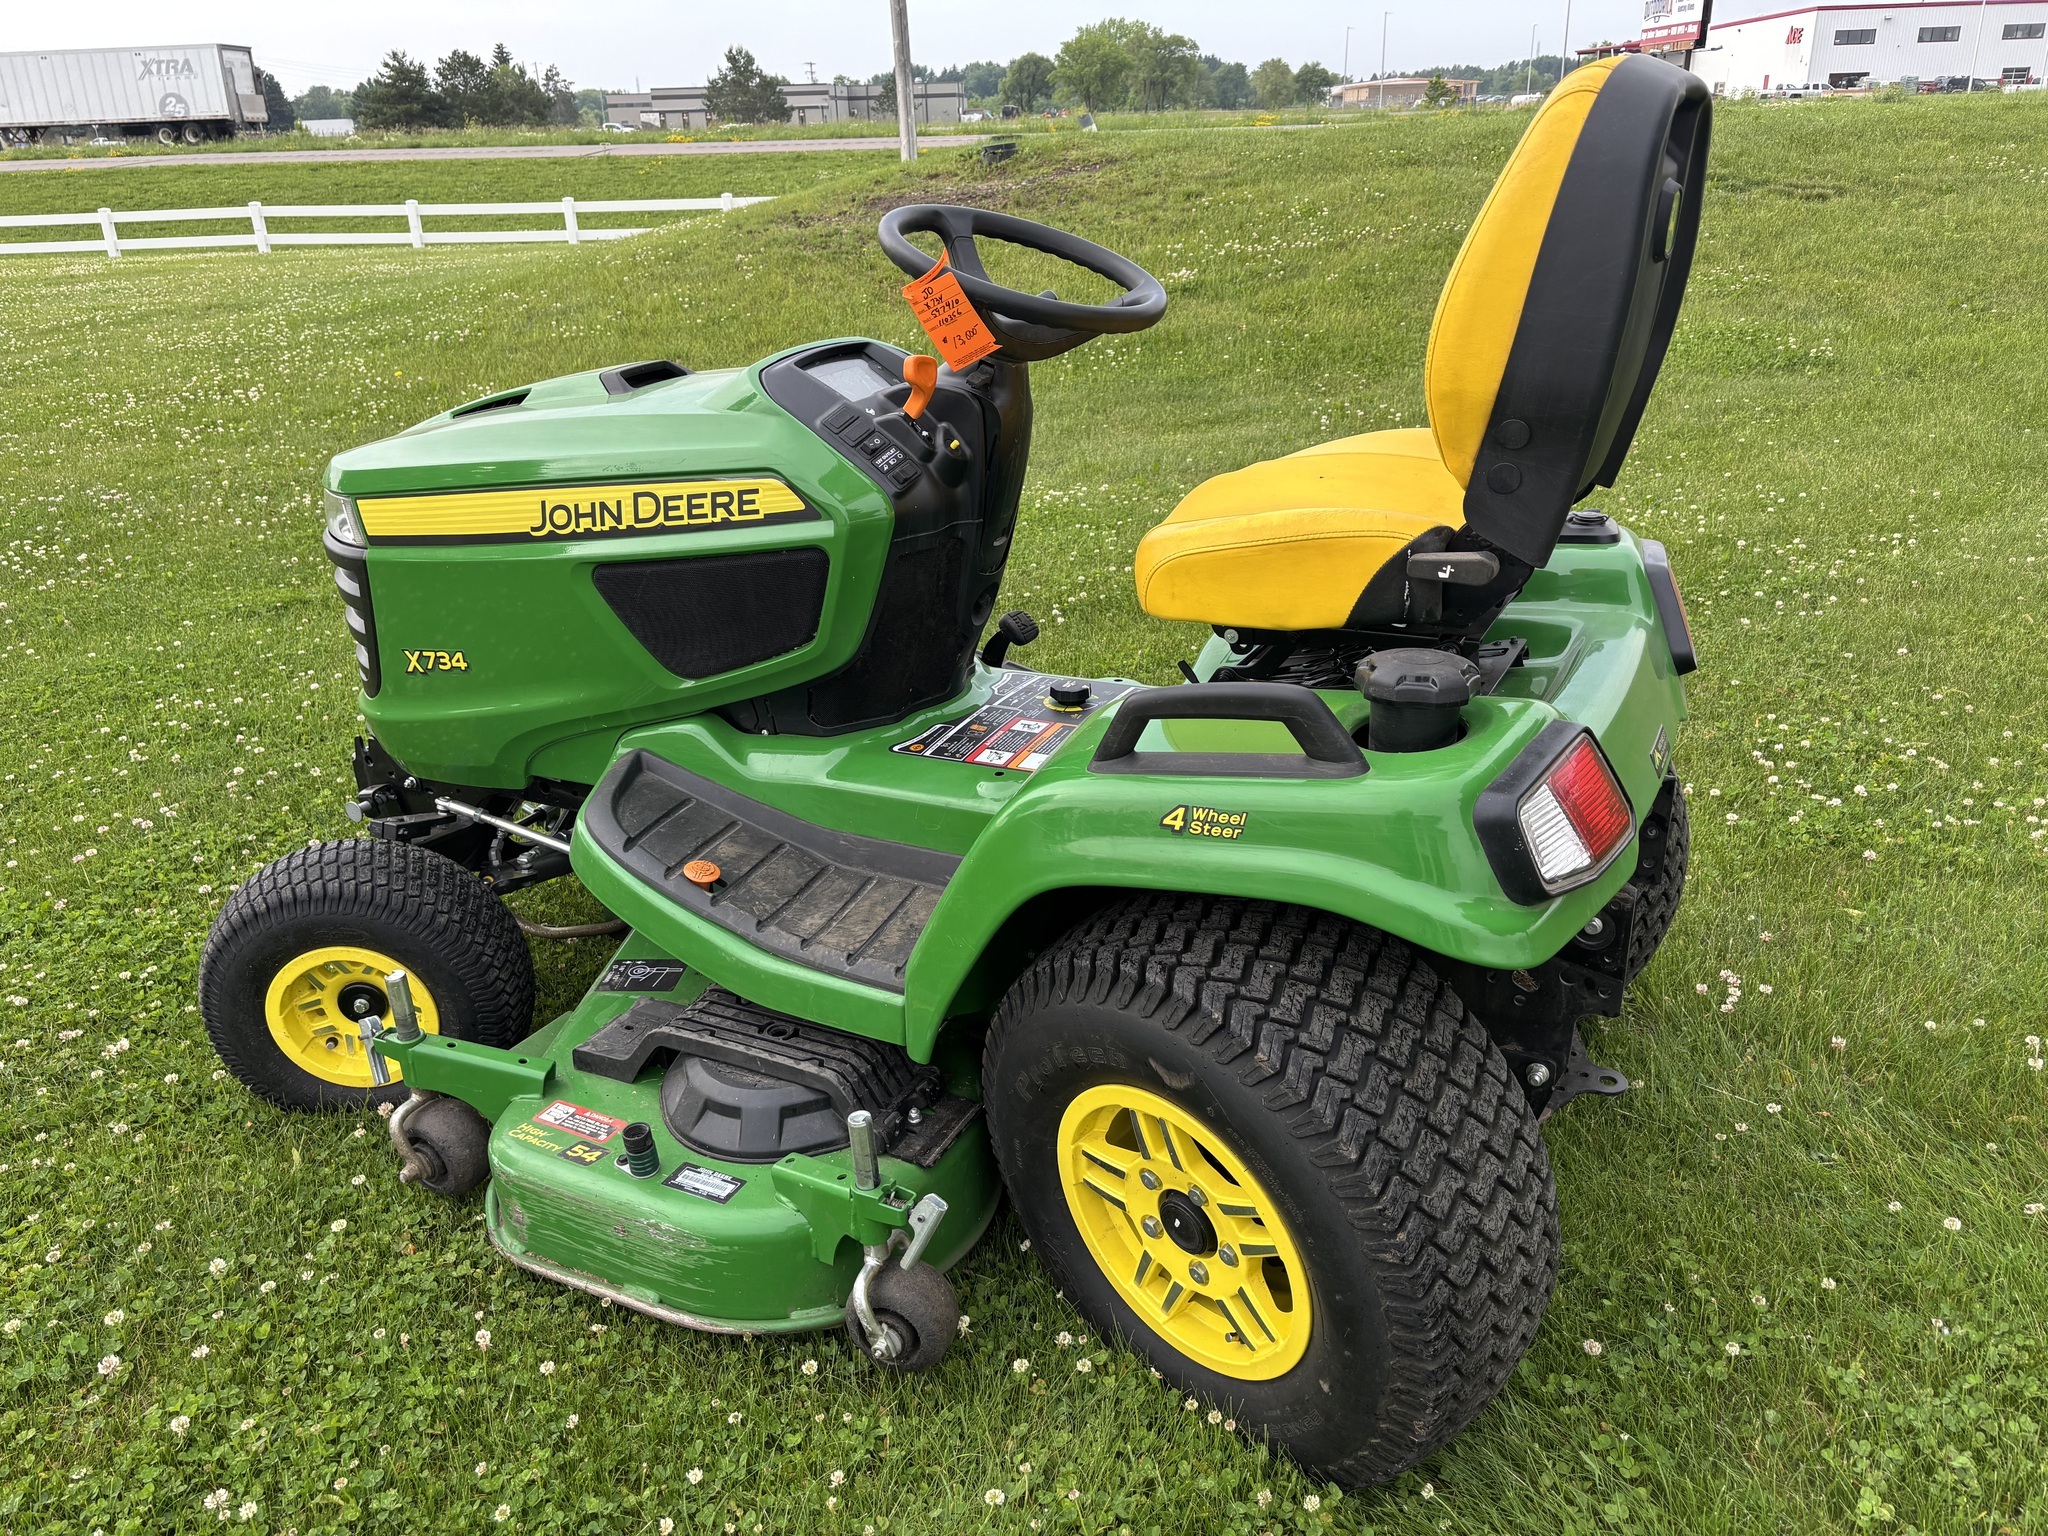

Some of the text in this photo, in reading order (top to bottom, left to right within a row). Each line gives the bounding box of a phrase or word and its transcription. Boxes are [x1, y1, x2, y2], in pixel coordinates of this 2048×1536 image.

[138, 58, 195, 80] XTRA
[530, 488, 761, 533] JOHN DEERE
[401, 649, 469, 675] X734
[1160, 804, 1248, 833] 4 Wheel
[1188, 820, 1243, 839] Steer
[590, 1112, 614, 1124] DANGER
[508, 1129, 563, 1152] CAPACITY
[516, 1123, 548, 1137] HIGH
[566, 1144, 603, 1162] 54
